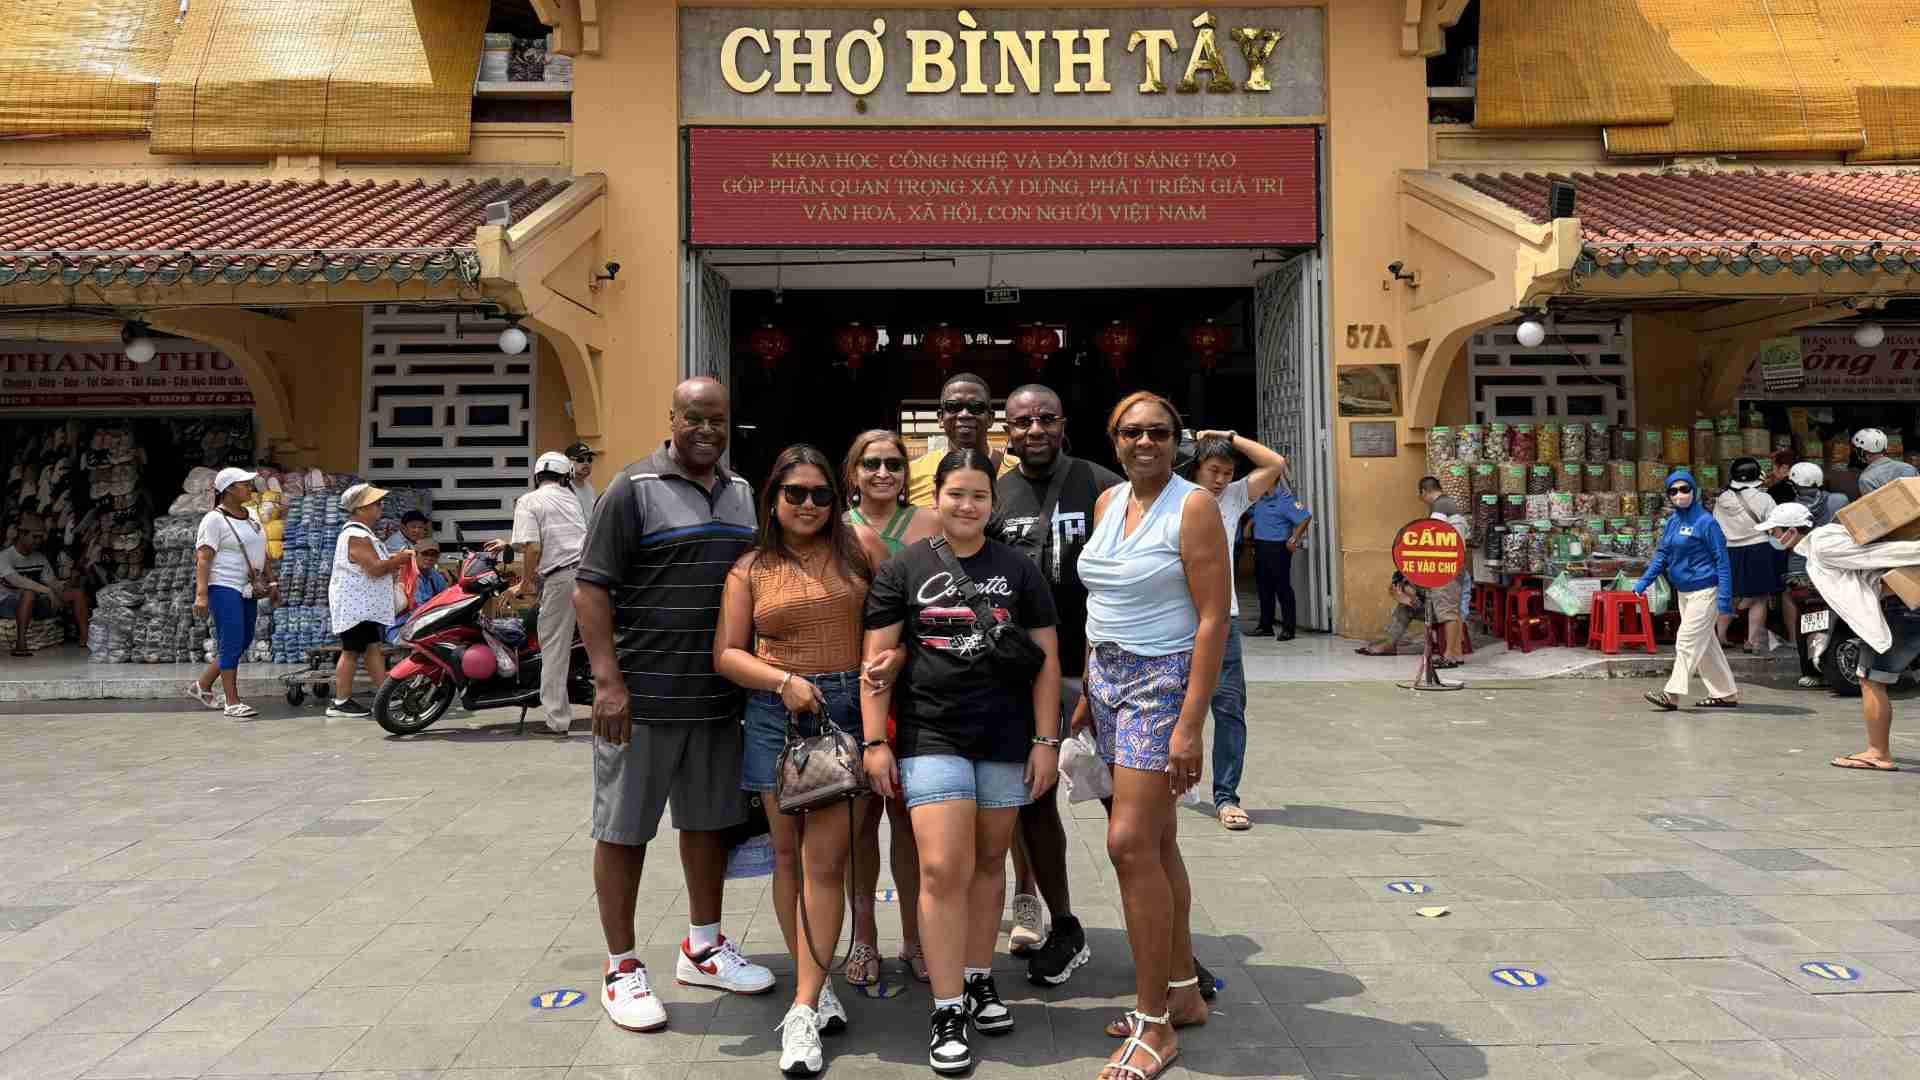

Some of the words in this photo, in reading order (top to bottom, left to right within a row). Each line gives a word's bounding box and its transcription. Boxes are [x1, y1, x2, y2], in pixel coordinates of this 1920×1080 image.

[720, 18, 886, 113] CHỢ
[906, 10, 1111, 93] BÌNH
[1127, 11, 1284, 93] TÂY
[771, 152, 831, 169] KHOA
[836, 152, 885, 171] HỌC,
[888, 150, 948, 168] CÔNG
[952, 150, 1008, 171] NGHỆ
[1014, 150, 1042, 168] VÀ
[1089, 150, 1129, 168] MỚI
[1134, 149, 1191, 168] SÁNG
[1193, 152, 1237, 171] TẠO
[722, 176, 764, 193] GÓP
[830, 178, 889, 197] QUAN
[895, 178, 965, 197] TRỌNG
[970, 176, 1014, 194] XÂY
[1088, 176, 1140, 194] PHÁT
[1210, 175, 1247, 193] GIÁ
[1252, 177, 1285, 196] TRỊ
[802, 202, 848, 220] VĂN
[908, 202, 937, 221] XÃ
[987, 206, 1032, 221] CON
[1036, 202, 1101, 221] NGƯỜI
[1109, 203, 1152, 223] VIỆT
[1158, 205, 1208, 221] NAM
[1346, 323, 1392, 349] 57A
[1403, 527, 1457, 547] CẤM
[1403, 559, 1415, 573] XE
[1417, 559, 1437, 574] VÀO
[917, 571, 1013, 603] Coette
